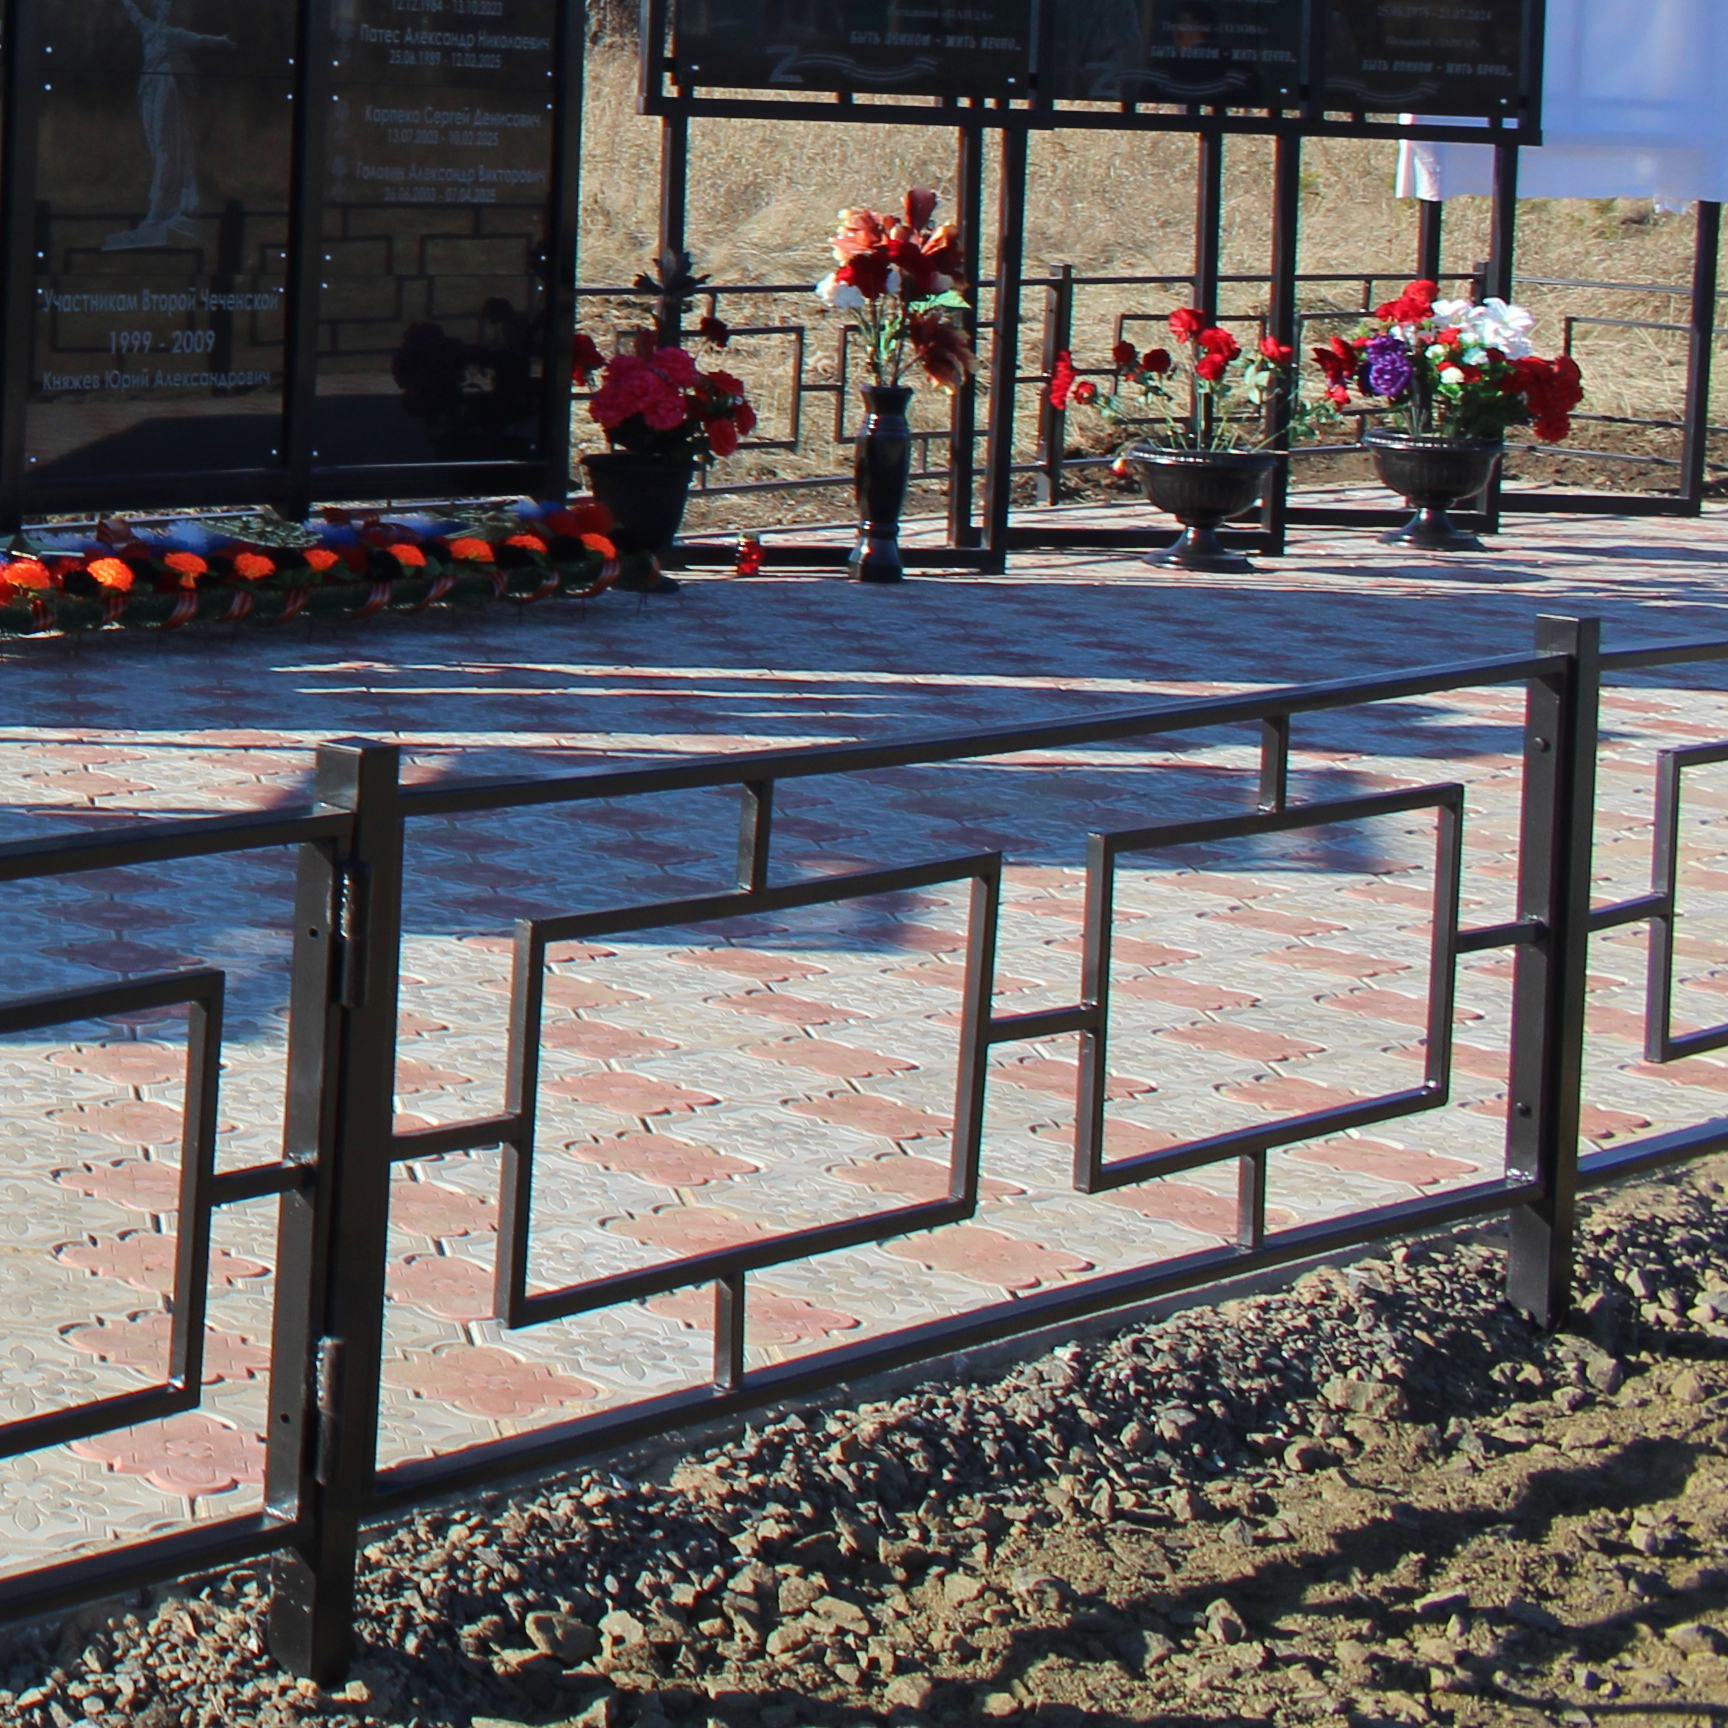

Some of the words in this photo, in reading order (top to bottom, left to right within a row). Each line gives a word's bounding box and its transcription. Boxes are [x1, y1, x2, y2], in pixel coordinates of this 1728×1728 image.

[360, 23, 401, 43] Патес
[403, 26, 475, 50] Александр
[478, 29, 550, 50] Николаевич
[364, 103, 421, 126] Карпеко
[423, 105, 470, 127] Сергей
[472, 108, 541, 128] Денисович
[356, 160, 405, 181] Головин
[407, 163, 475, 185] Александр
[478, 164, 546, 186] Викторович
[42, 288, 138, 313] Участникам
[141, 286, 196, 317] Второй
[200, 286, 278, 312] Чеченской
[109, 329, 153, 354] 1999
[171, 329, 216, 354] 2009
[42, 370, 100, 390] Княжев
[104, 367, 149, 392] Юрий
[153, 369, 272, 390] Александрович
